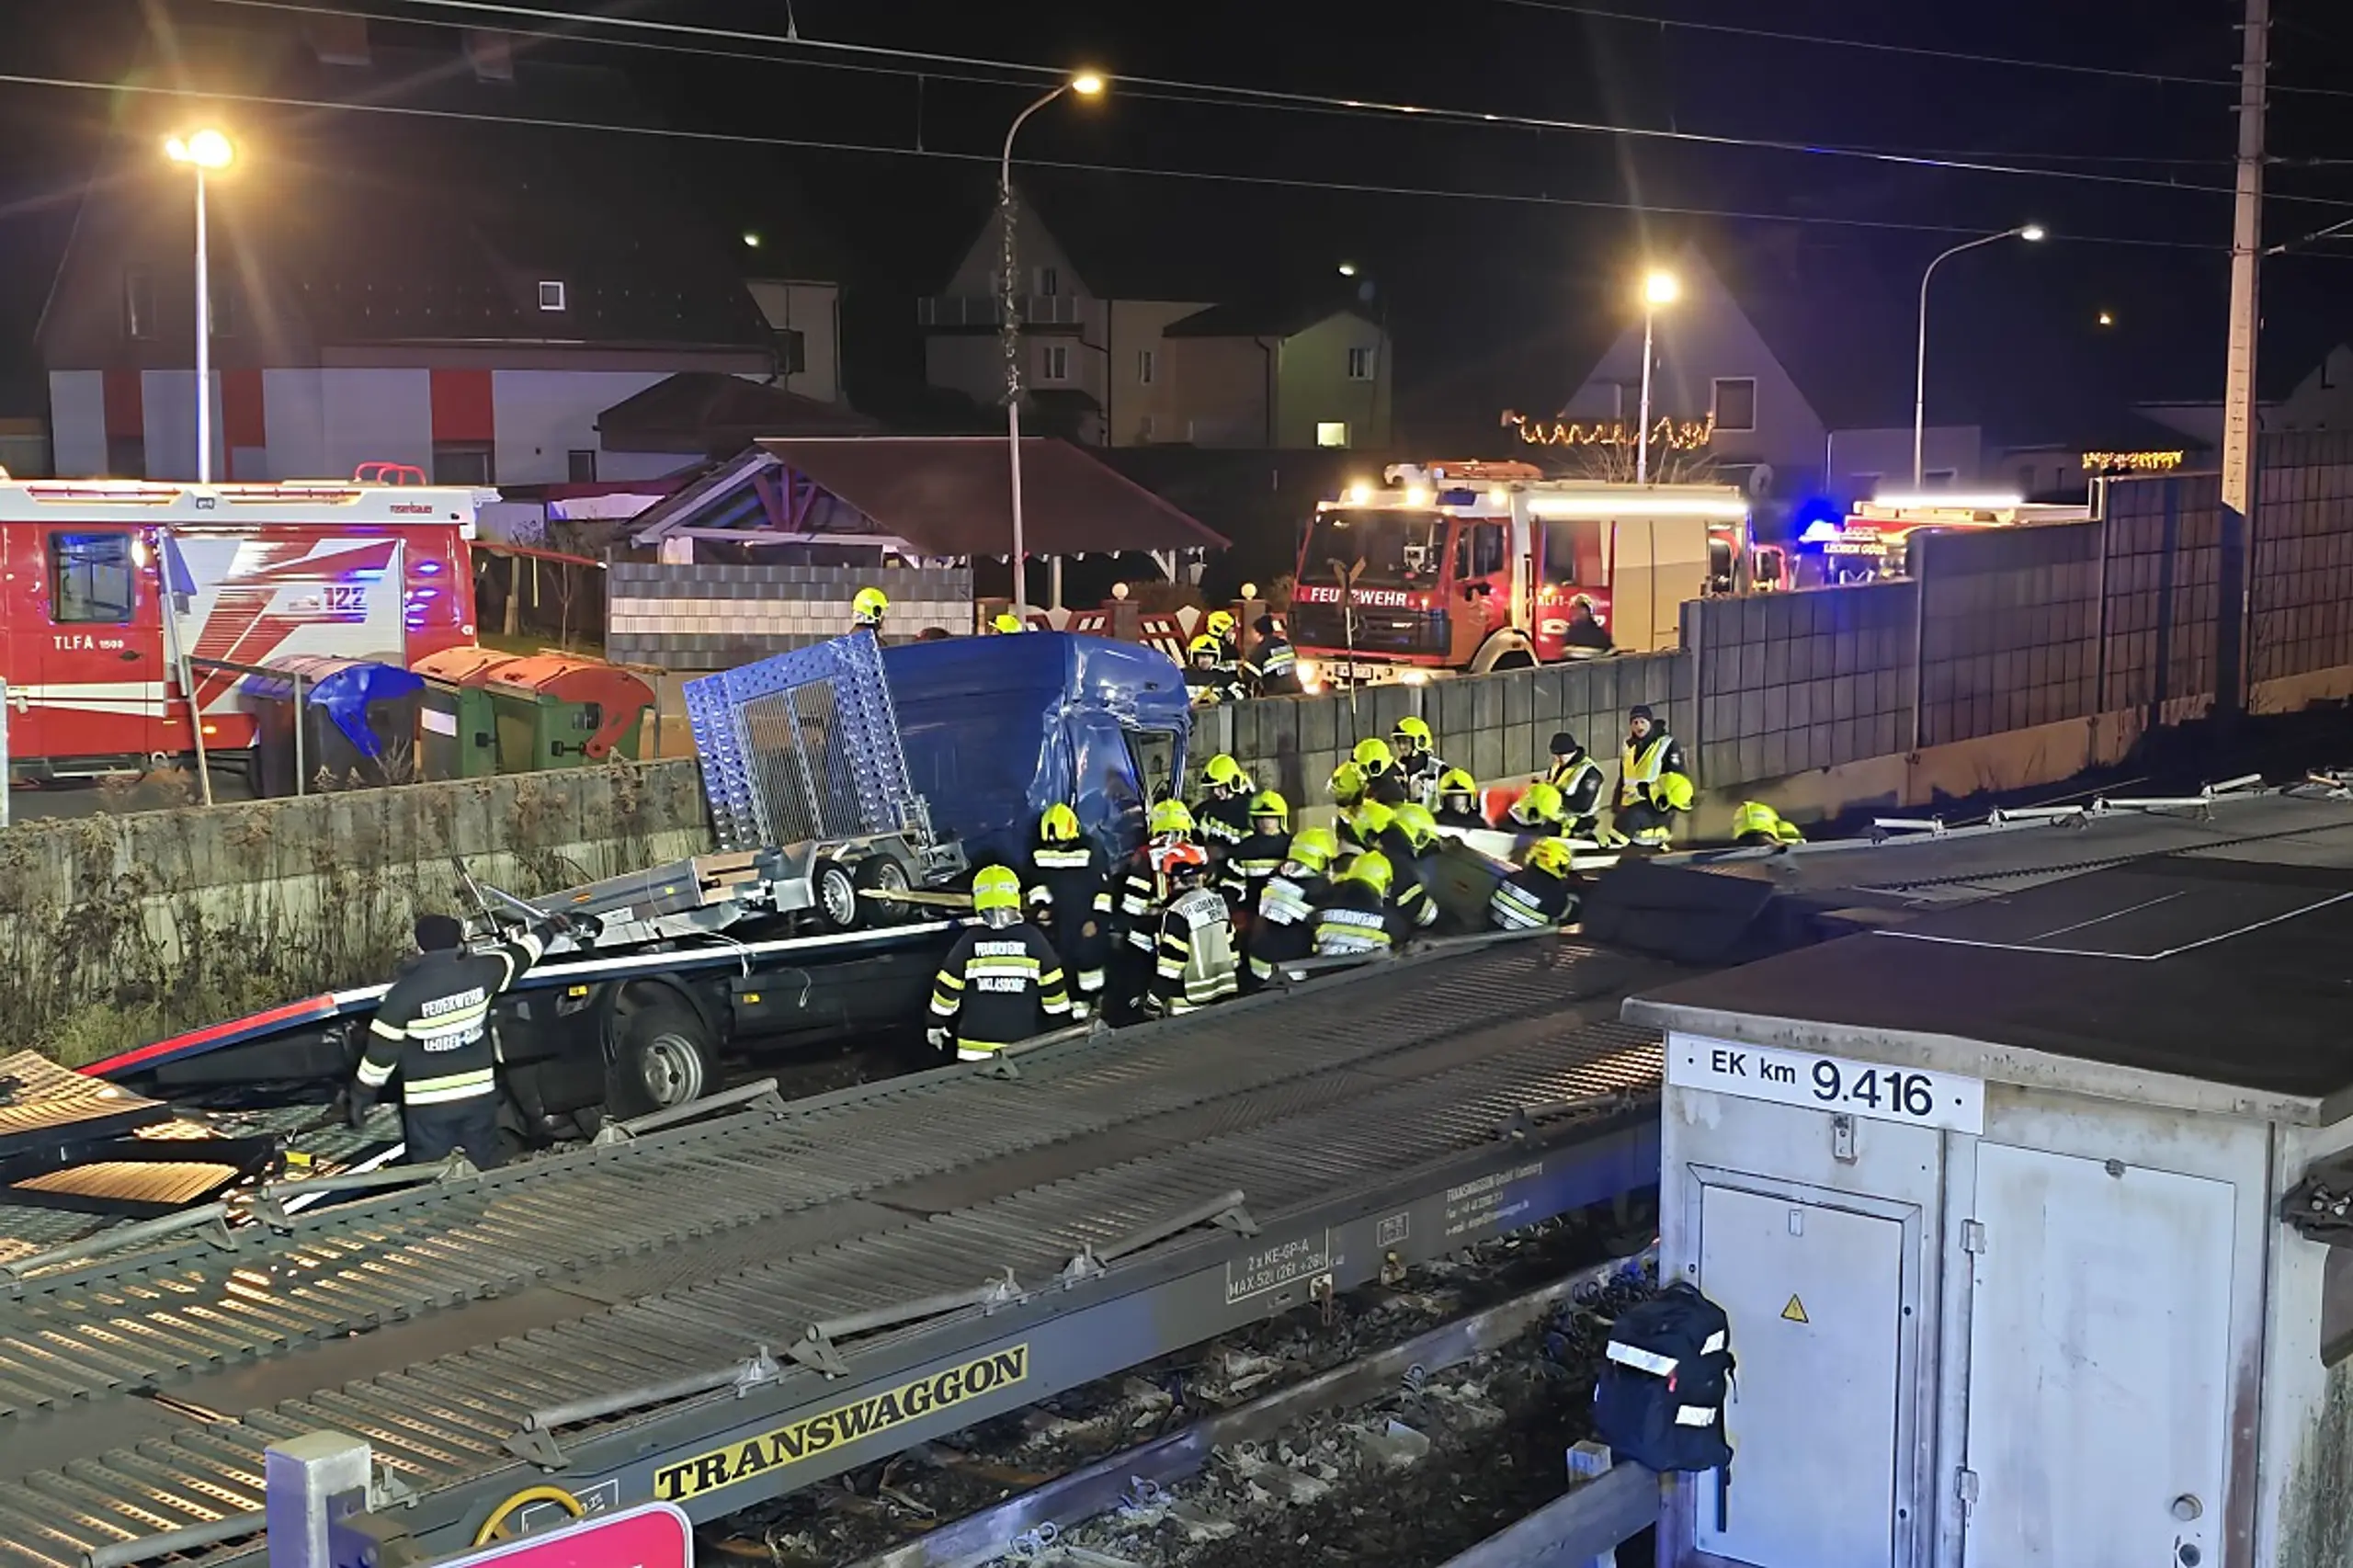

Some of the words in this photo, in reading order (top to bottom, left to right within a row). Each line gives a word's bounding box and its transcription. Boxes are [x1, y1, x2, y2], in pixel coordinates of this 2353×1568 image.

[324, 586, 367, 610] 122
[1311, 587, 1407, 607] FEURWEHR
[53, 635, 94, 651] TLFA
[1711, 1050, 1746, 1076] EK
[1760, 1058, 1795, 1084] km
[1812, 1060, 1933, 1116] 9.416
[659, 1348, 1026, 1500] TRANSWAGGON
